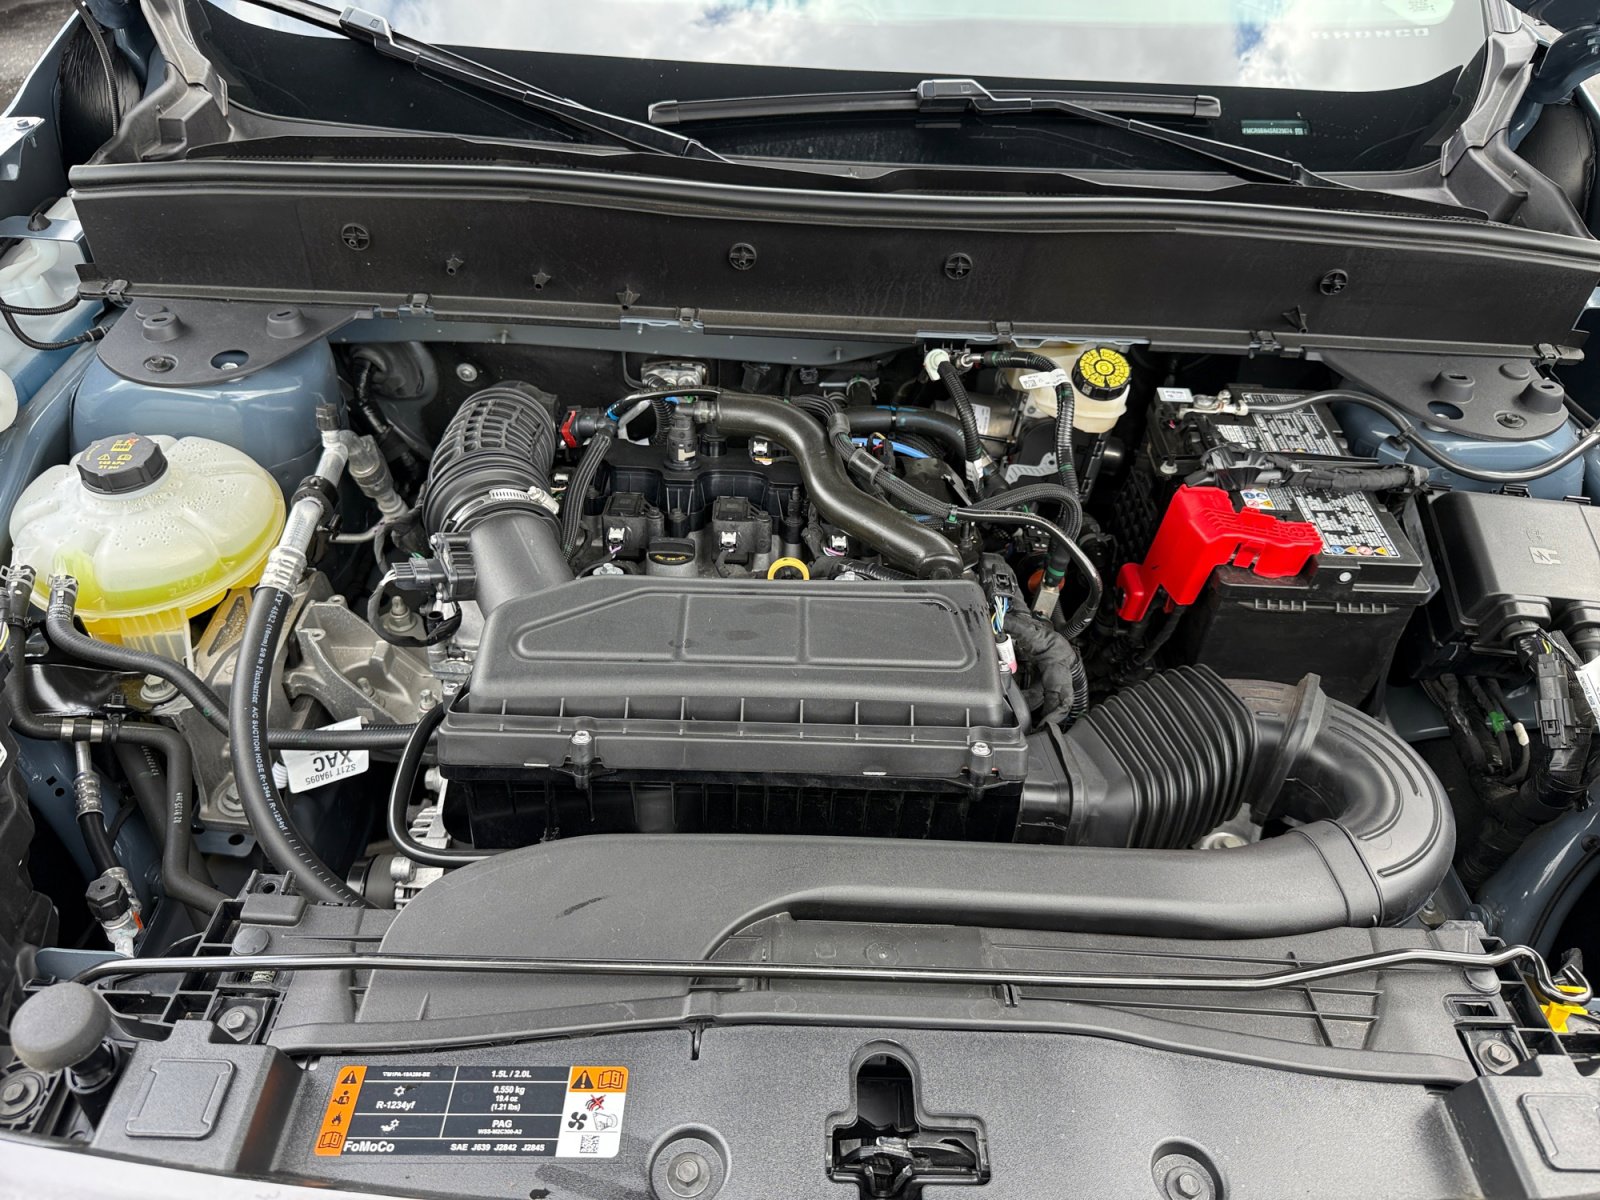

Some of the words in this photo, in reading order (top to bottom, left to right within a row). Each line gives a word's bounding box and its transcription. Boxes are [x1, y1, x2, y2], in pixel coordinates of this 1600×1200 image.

[252, 665, 264, 704] Flexbarrier
[252, 720, 261, 751] SUCTION
[255, 753, 265, 773] HOSE
[313, 749, 353, 772] XAC
[305, 770, 333, 785] 19A095
[260, 774, 271, 798] R-134a
[491, 1070, 508, 1078] 1.5L
[514, 1070, 532, 1078] 2.0L
[493, 1086, 514, 1094] 0.550
[515, 1086, 526, 1095] kg
[376, 1101, 416, 1111] R-1234yf
[491, 1104, 507, 1112] (1.21
[492, 1120, 513, 1128] PAG
[343, 1141, 395, 1152] FoMoCo
